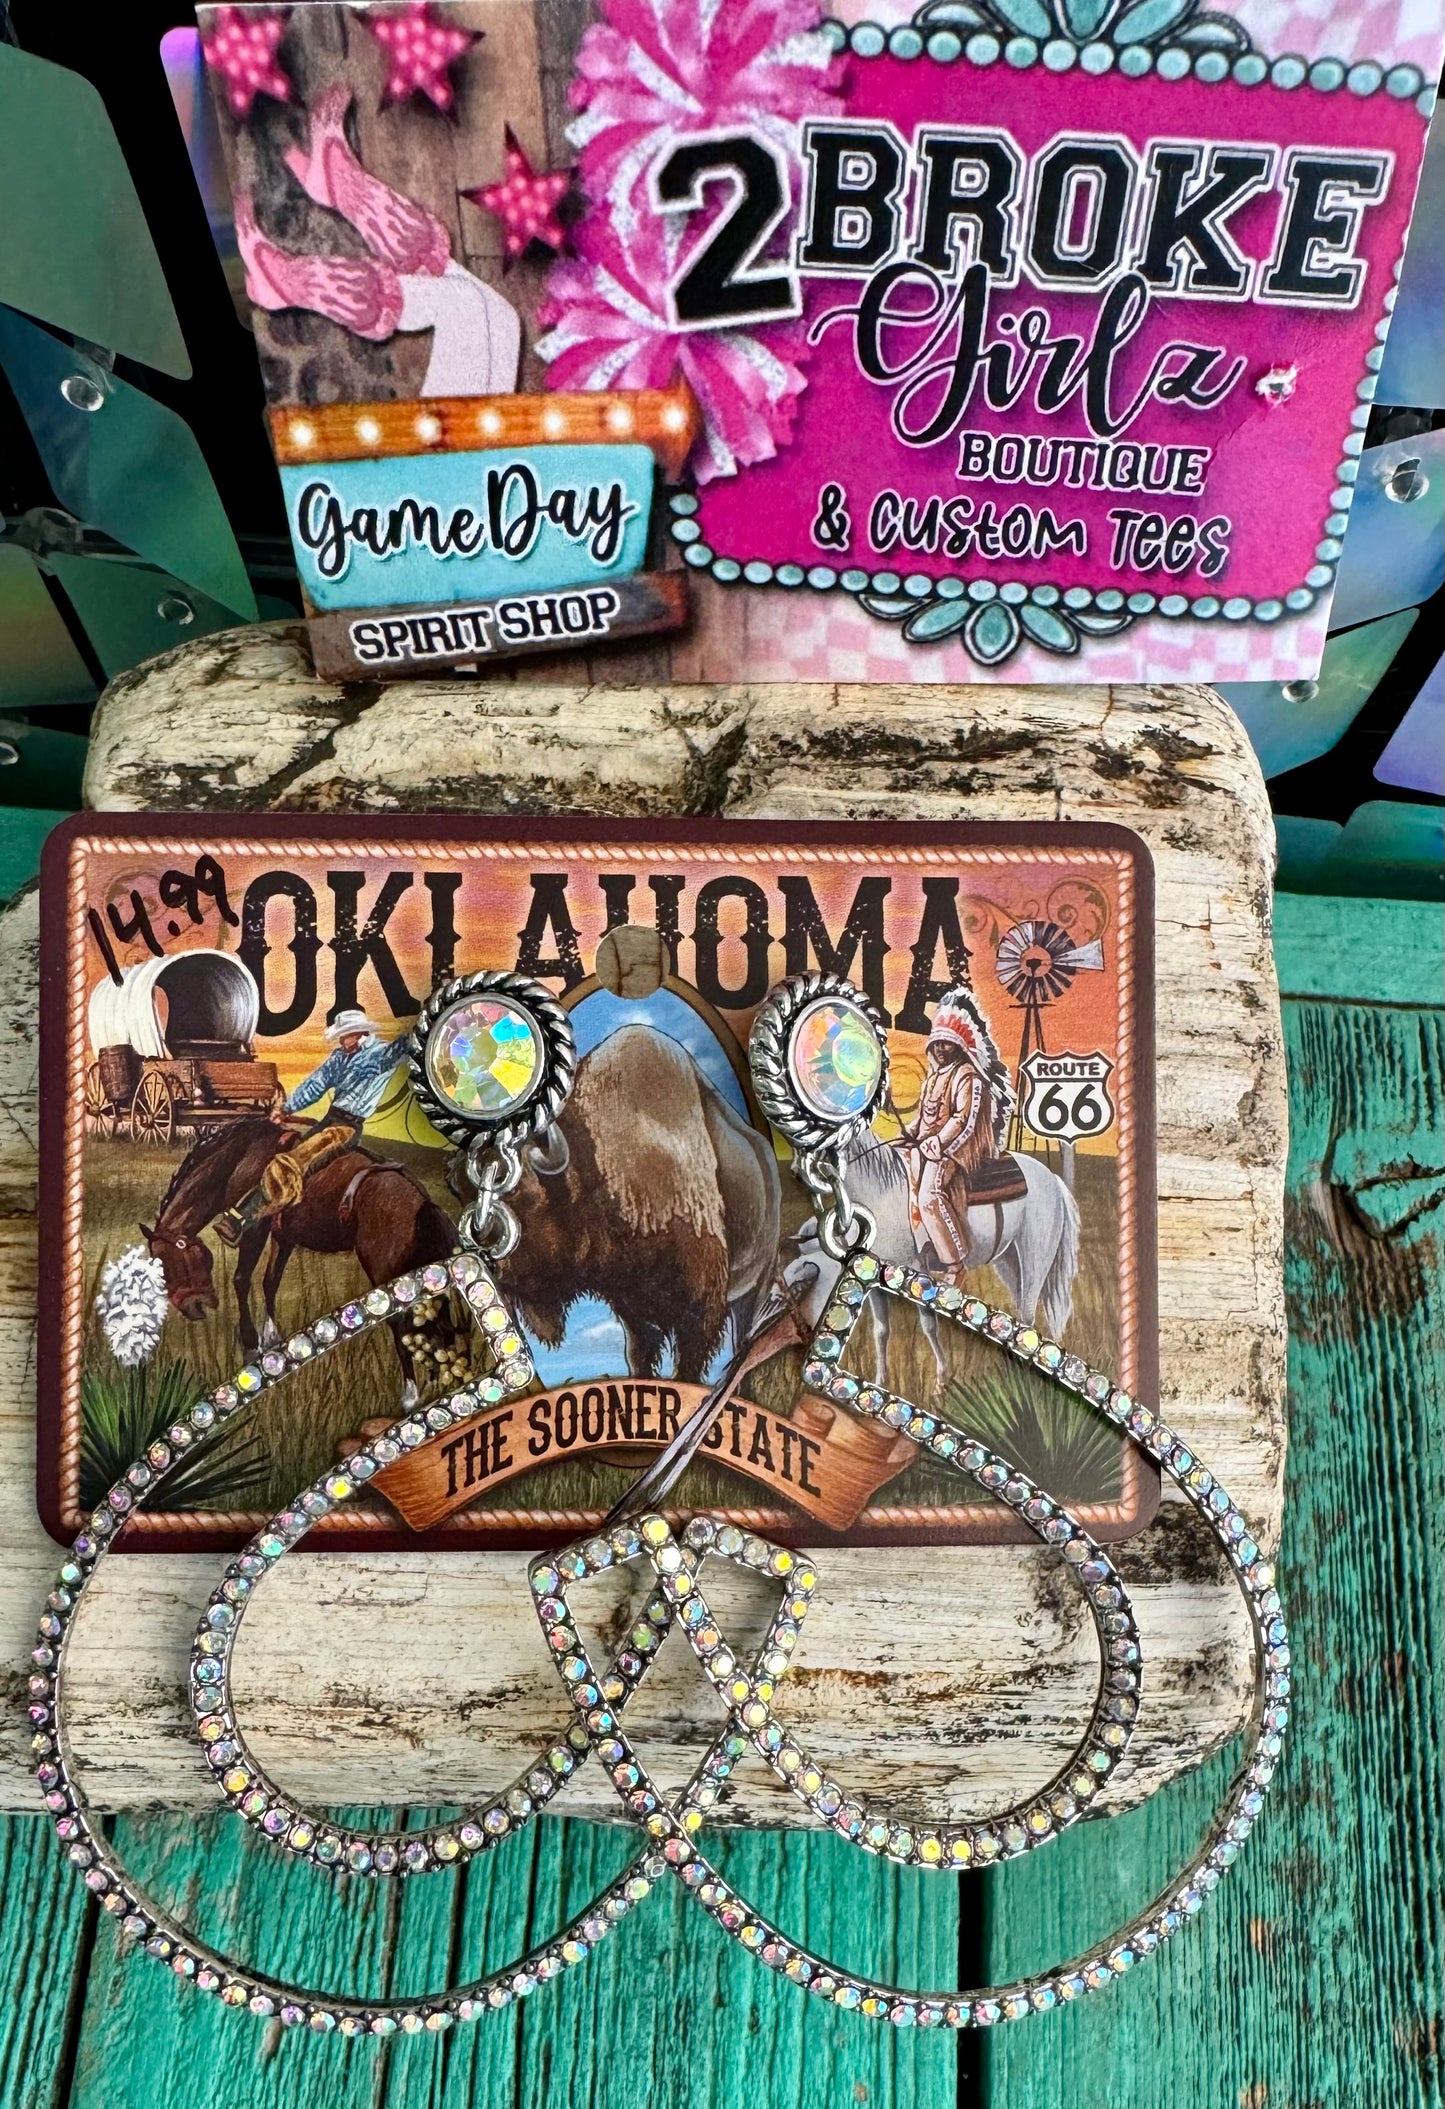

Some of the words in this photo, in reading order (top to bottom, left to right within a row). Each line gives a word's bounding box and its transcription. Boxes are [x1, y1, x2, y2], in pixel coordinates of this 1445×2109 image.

[652, 128, 802, 330] 2
[800, 118, 1394, 308] BROKE
[808, 262, 1246, 446] Girlz
[957, 432, 1210, 496] BOUTIQUE
[813, 482, 850, 550] &
[351, 607, 492, 662] SPIRIT
[498, 588, 622, 640] SHOP
[88, 854, 240, 986] 14.99
[1036, 1061, 1101, 1077] ROUTE
[1038, 1083, 1102, 1131] 66
[440, 1411, 514, 1498] THE
[526, 1385, 682, 1456] SOONER
